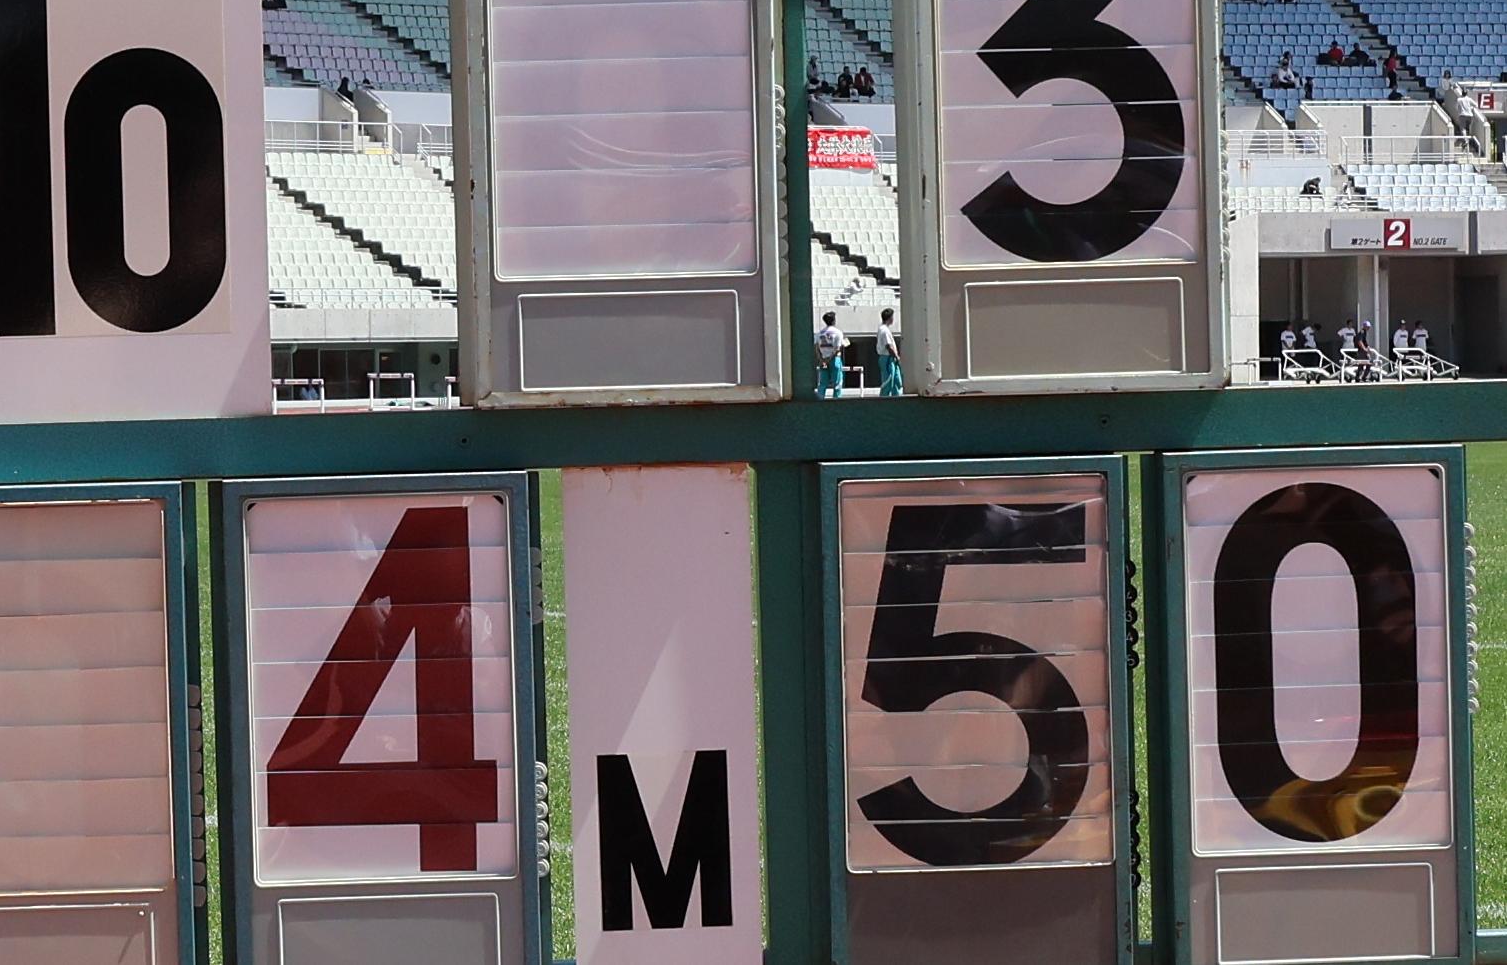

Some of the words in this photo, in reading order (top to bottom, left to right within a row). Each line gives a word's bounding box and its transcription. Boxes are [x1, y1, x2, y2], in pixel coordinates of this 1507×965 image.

[1479, 93, 1492, 109] E
[1387, 220, 1406, 246] 2
[1350, 237, 1381, 246] 第2ゲート
[1413, 237, 1429, 246] NO.2
[1430, 237, 1448, 246] GATE
[266, 506, 499, 872] 4
[597, 749, 734, 932] M
[856, 502, 1090, 867] 5
[1213, 481, 1420, 843] 0
